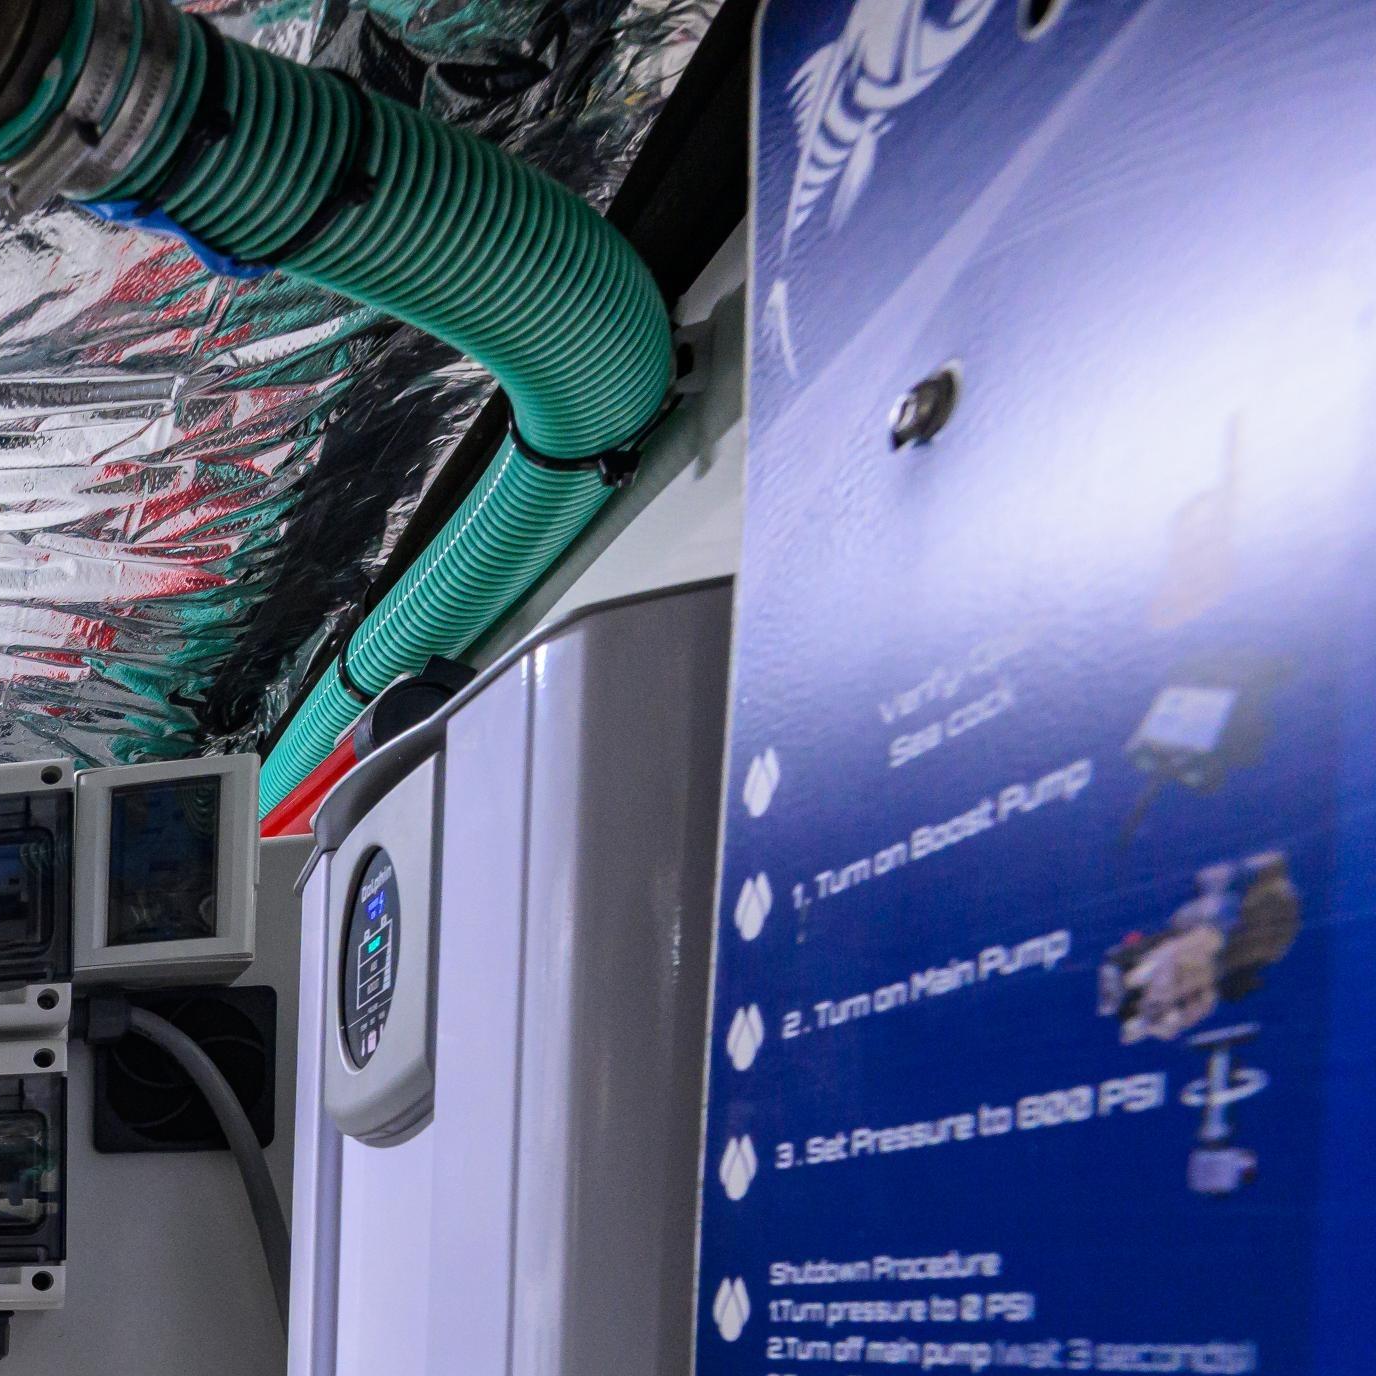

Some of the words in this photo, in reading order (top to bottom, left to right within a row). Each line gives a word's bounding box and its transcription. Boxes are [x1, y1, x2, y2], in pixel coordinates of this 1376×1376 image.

[814, 857, 871, 899] Turn
[873, 842, 908, 876] on
[909, 799, 994, 861] Boost
[996, 757, 1093, 823] Pump
[360, 865, 393, 904] Dolphin
[814, 993, 871, 1029] Turn
[873, 981, 908, 1011] on
[909, 958, 975, 1001] Main
[977, 928, 1071, 981] Pump
[805, 1131, 848, 1164] Set
[849, 1111, 975, 1158] Pressure
[976, 1103, 1014, 1137] to
[1097, 1072, 1168, 1117] PSI
[768, 1258, 871, 1286] Shutdown
[872, 1250, 1003, 1281] Procedure
[826, 1299, 928, 1328] pressure
[929, 1295, 958, 1323] to
[984, 1291, 1036, 1322] PSI
[833, 1335, 865, 1362] off
[865, 1336, 920, 1363] main
[921, 1341, 992, 1374] pump
[1065, 1338, 1094, 1370] 3
